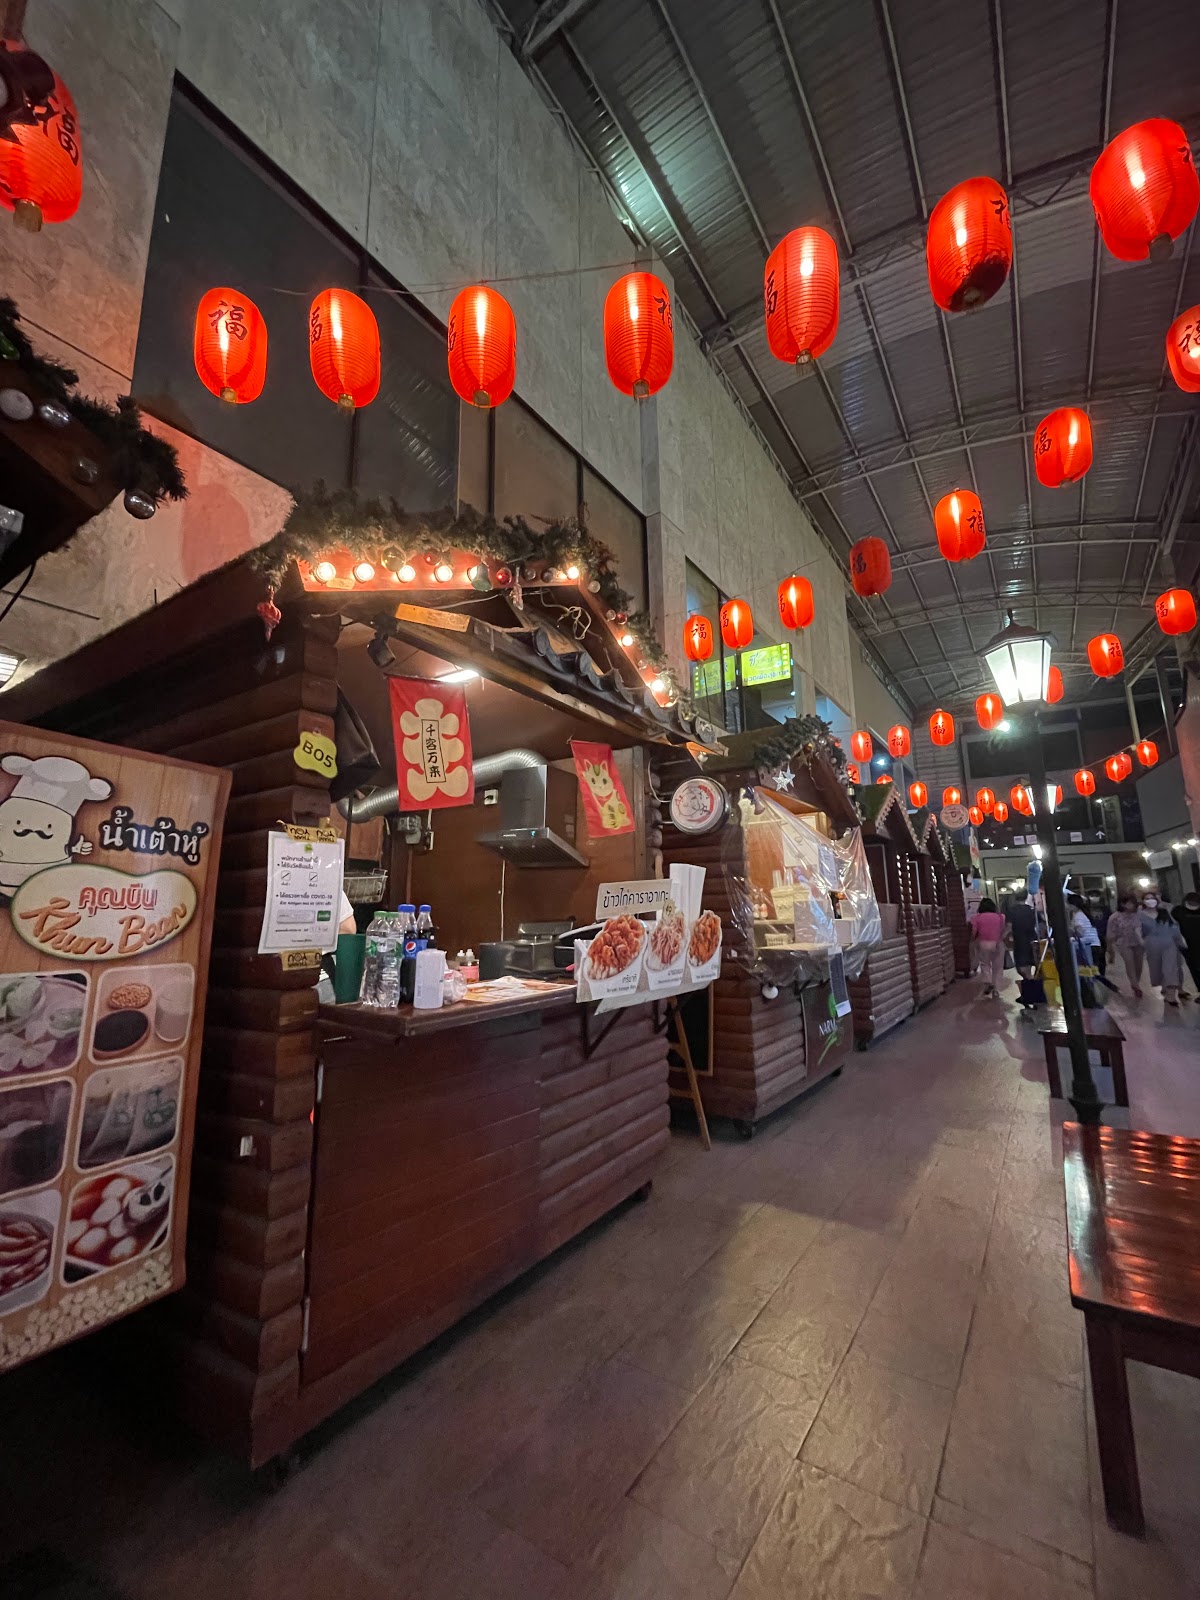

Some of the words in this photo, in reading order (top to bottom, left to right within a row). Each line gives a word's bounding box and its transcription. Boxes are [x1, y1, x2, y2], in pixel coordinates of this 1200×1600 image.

[208, 300, 248, 341] 福
[966, 508, 984, 533] 福
[691, 623, 707, 640] 福
[103, 809, 207, 862] น้ำเต้าหู้
[118, 903, 187, 954] Bean
